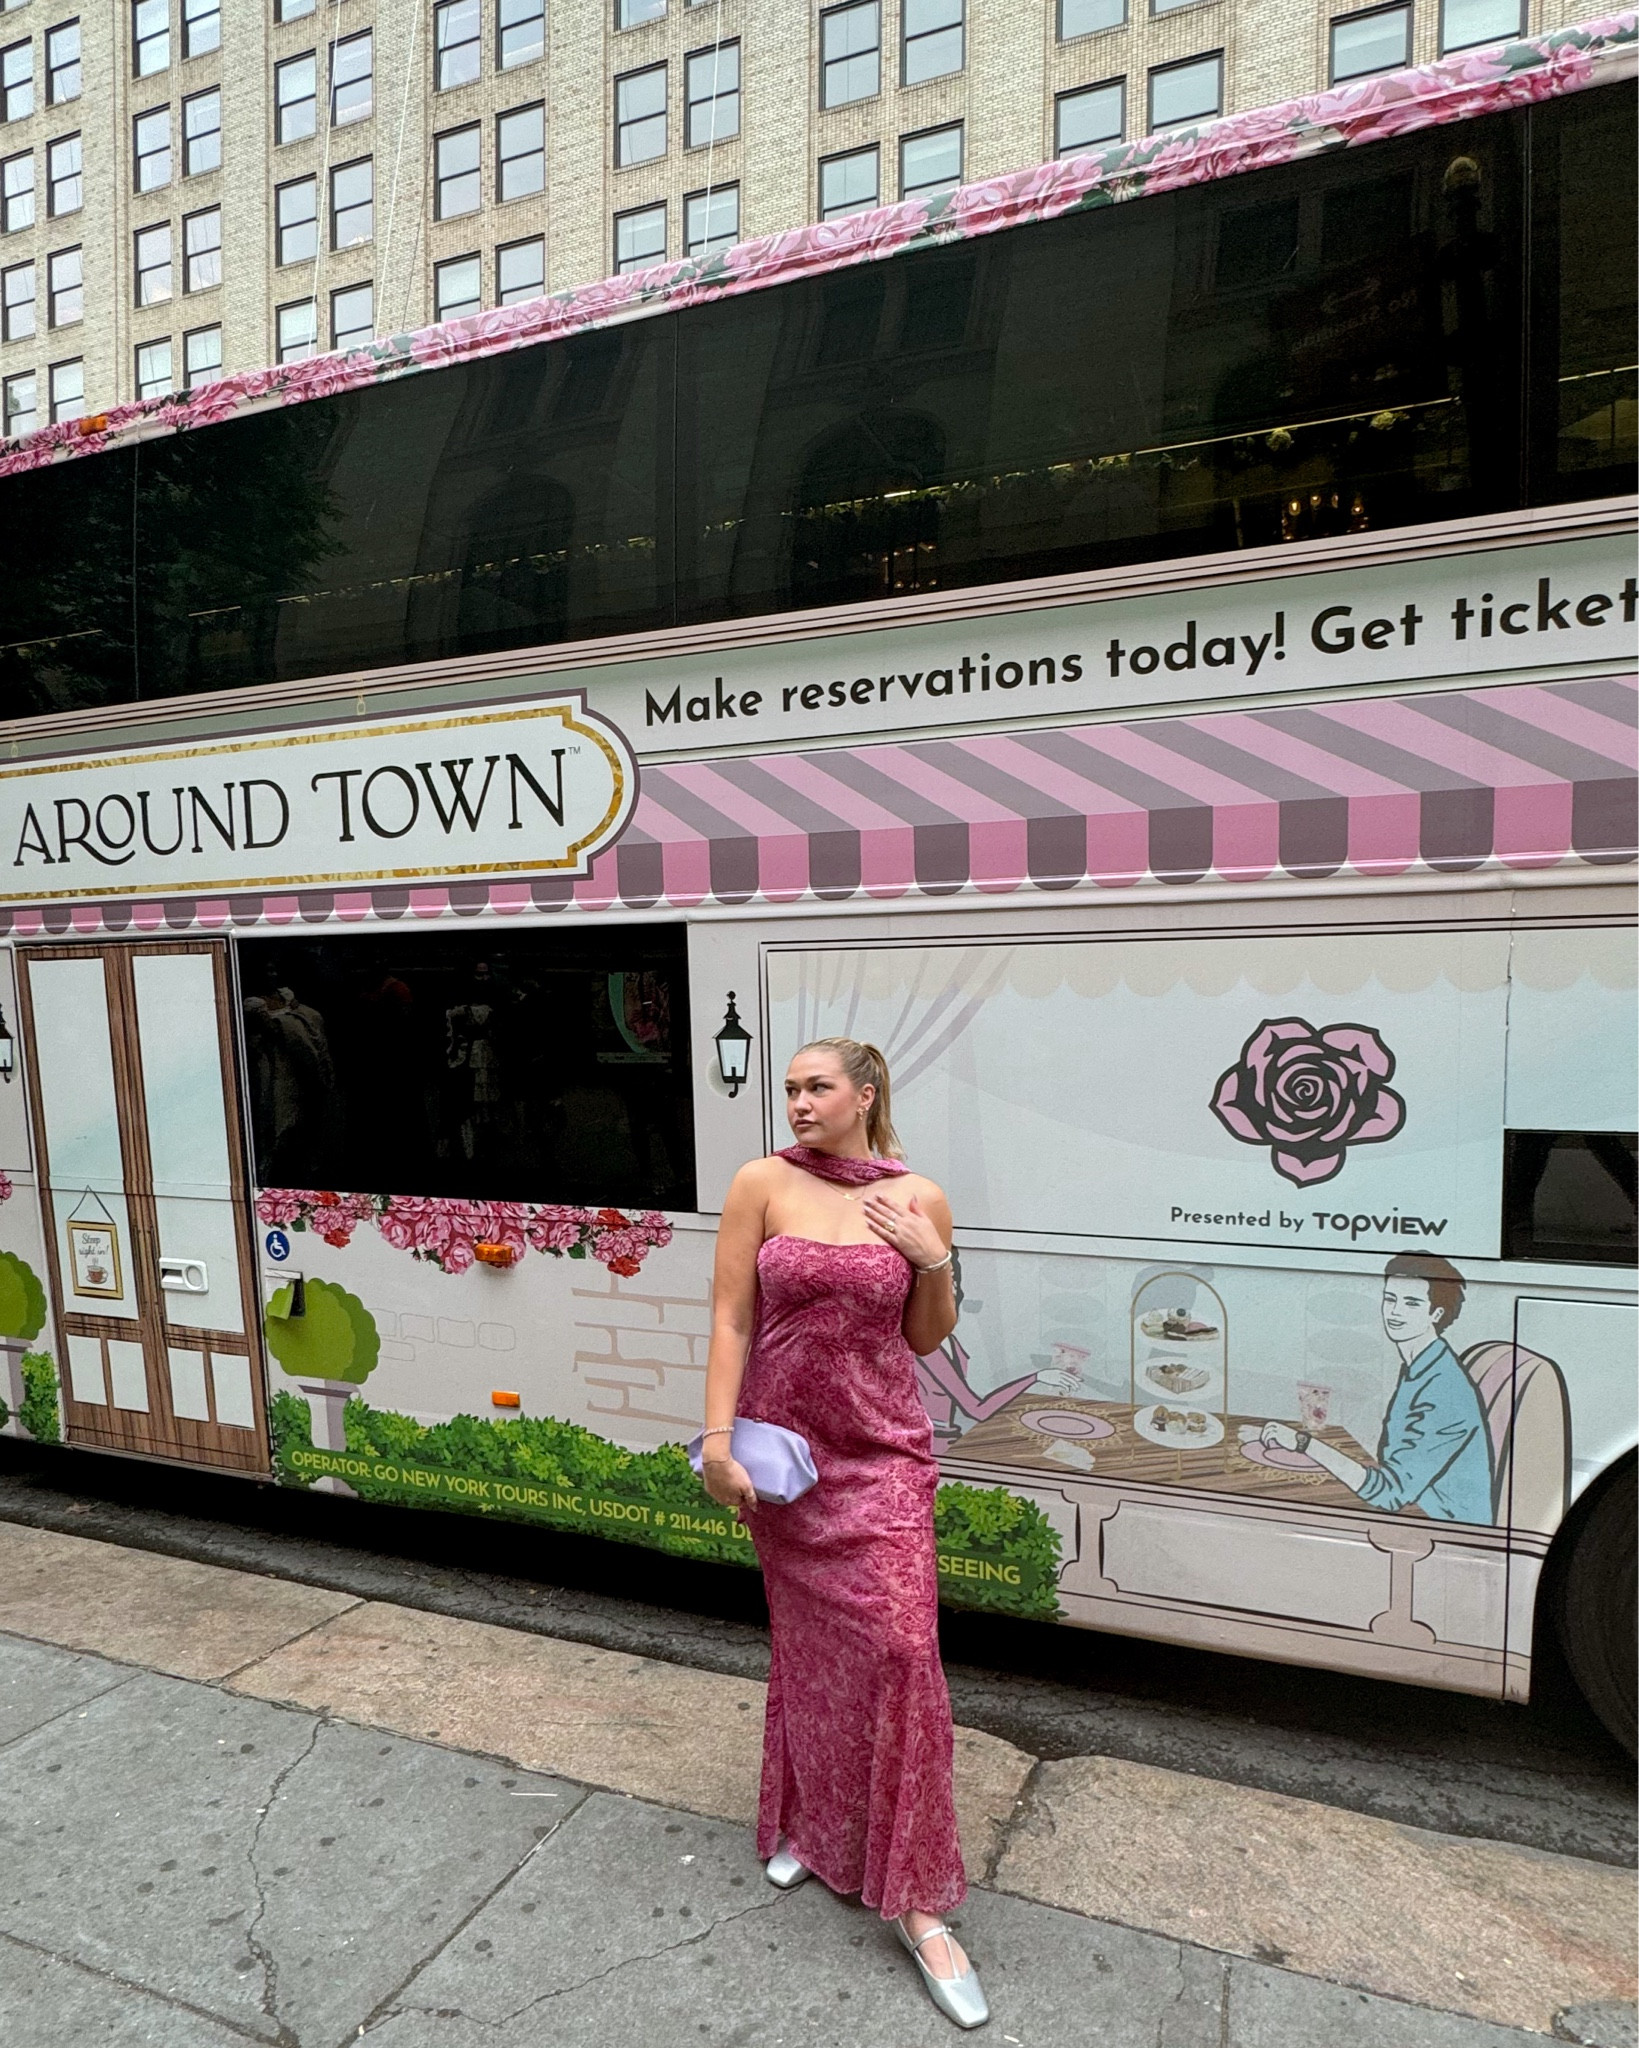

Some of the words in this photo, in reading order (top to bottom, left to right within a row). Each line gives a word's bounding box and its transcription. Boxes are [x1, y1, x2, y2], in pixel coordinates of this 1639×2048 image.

[645, 676, 763, 727] Make
[781, 653, 1084, 712] reservations
[1105, 610, 1286, 677] today!
[1310, 604, 1423, 655] Get
[1451, 577, 1638, 640] ticket
[12, 778, 290, 867] AROUND
[310, 748, 566, 843] TOWN
[1170, 1206, 1271, 1228] Presented
[1279, 1211, 1304, 1232] by
[374, 1464, 399, 1482] GO
[402, 1468, 441, 1488] NEW
[444, 1474, 490, 1498] YORK
[493, 1483, 549, 1507] TOURS
[552, 1493, 587, 1516] INC,
[589, 1499, 650, 1524] USDOT
[654, 1511, 666, 1525] #
[669, 1513, 728, 1536] 2114416
[937, 1554, 1021, 1585] SEEING
